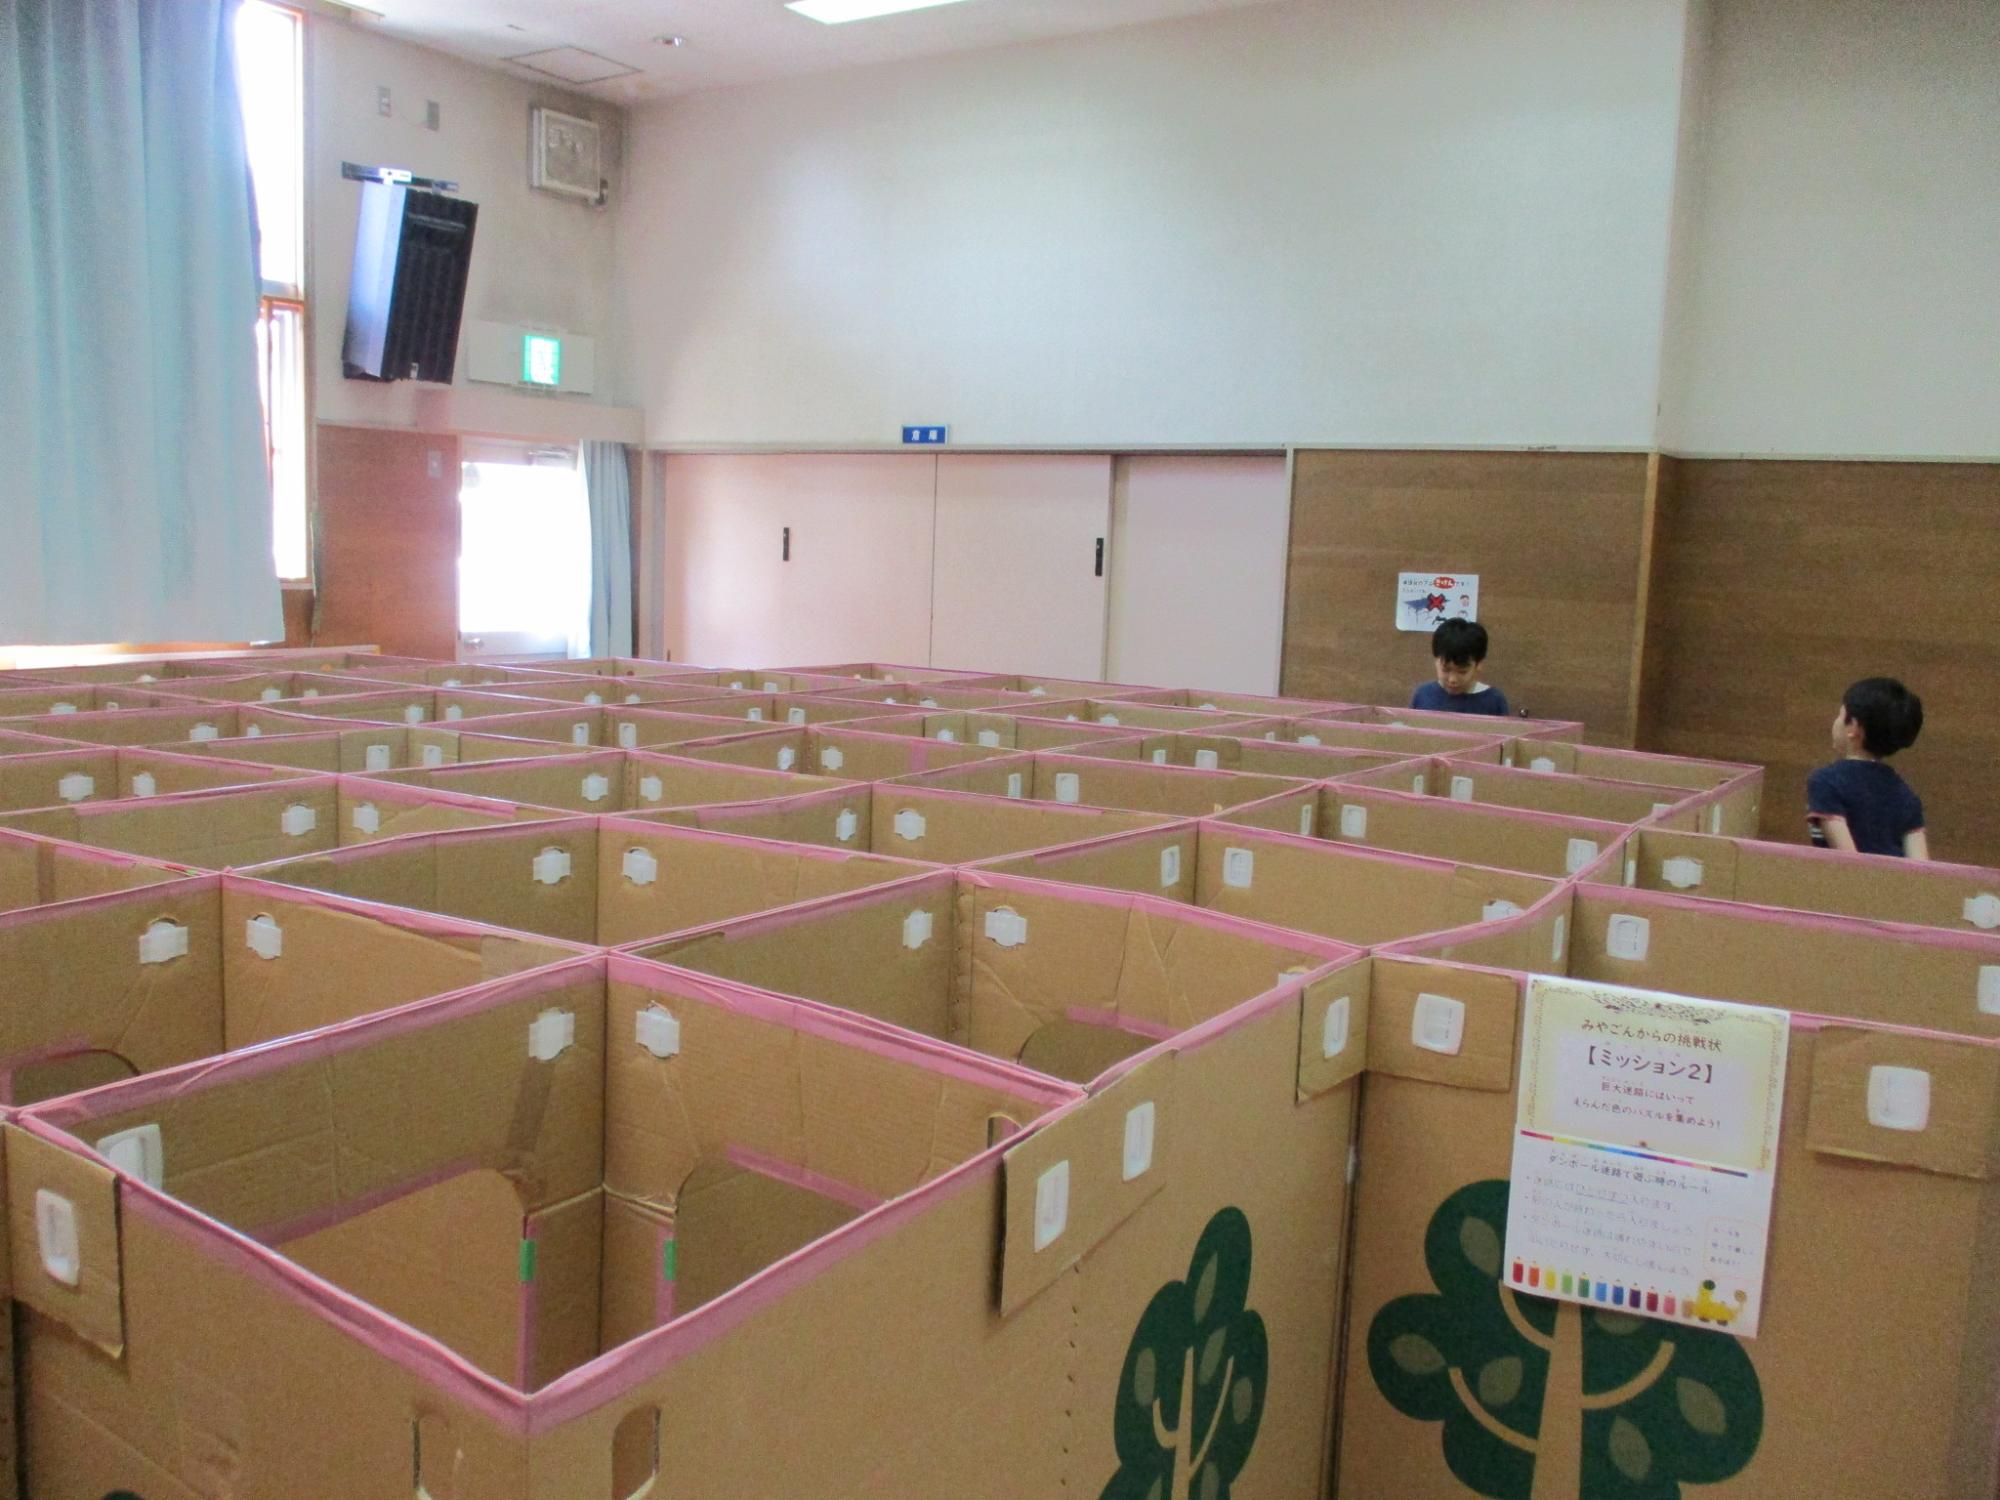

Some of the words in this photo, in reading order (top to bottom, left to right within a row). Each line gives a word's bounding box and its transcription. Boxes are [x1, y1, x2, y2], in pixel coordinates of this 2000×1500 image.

[1580, 1018, 1722, 1053] みやごんからの挑戦状
[1601, 1080, 1695, 1105] 巨大迷路にはいって
